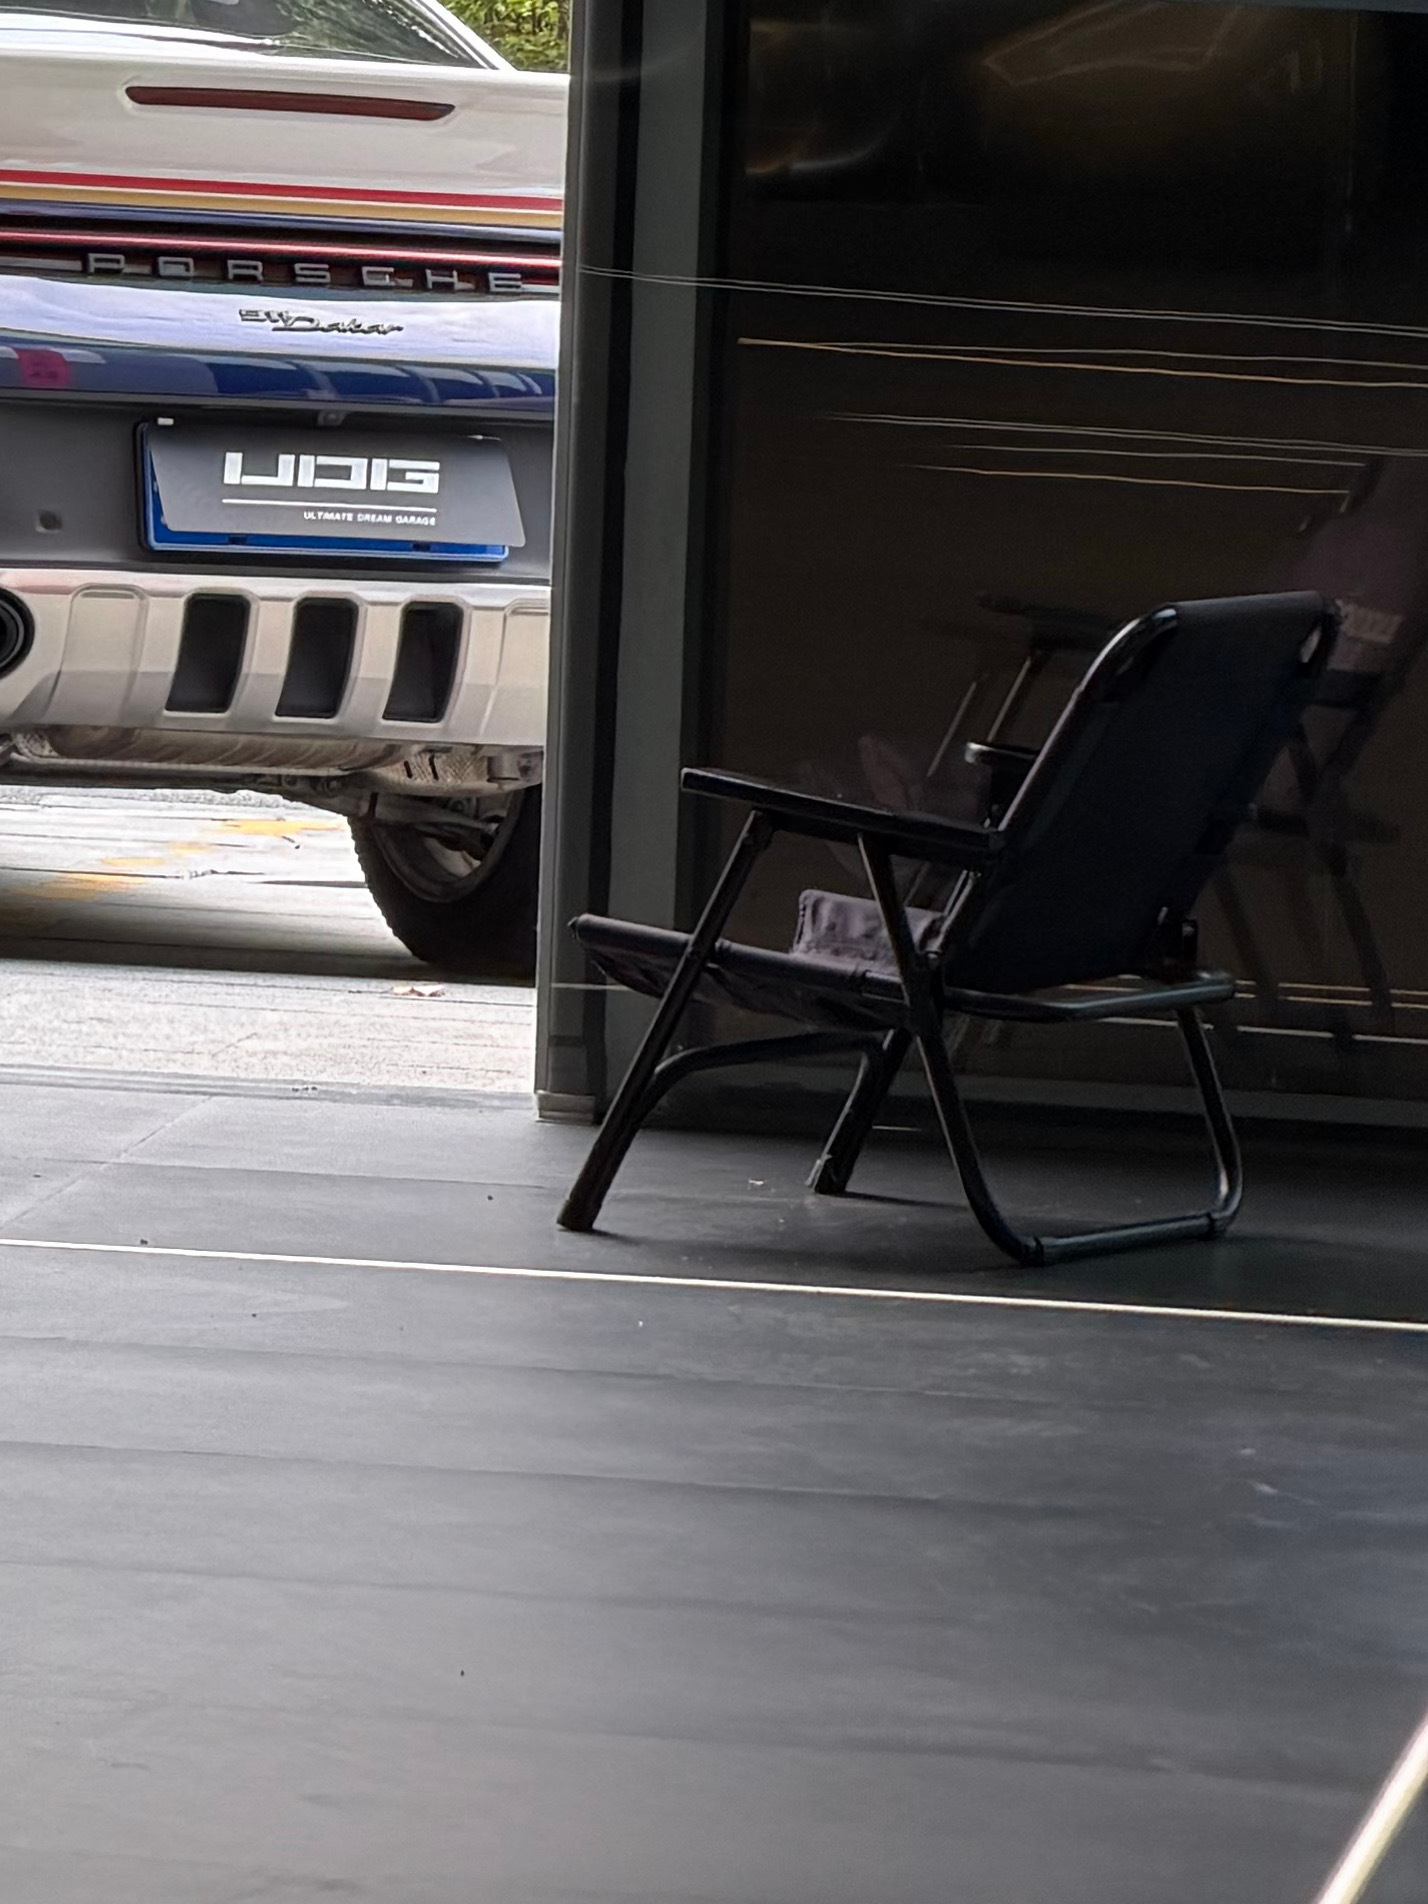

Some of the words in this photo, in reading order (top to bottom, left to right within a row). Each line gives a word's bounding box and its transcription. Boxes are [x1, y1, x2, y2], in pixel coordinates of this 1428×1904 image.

[87, 252, 523, 293] PORSCHE
[272, 315, 404, 336] Dakar
[222, 451, 440, 494] UDG
[303, 510, 354, 522] ULTIMATE
[357, 512, 393, 524] DREAM
[395, 515, 436, 527] GARAGE
